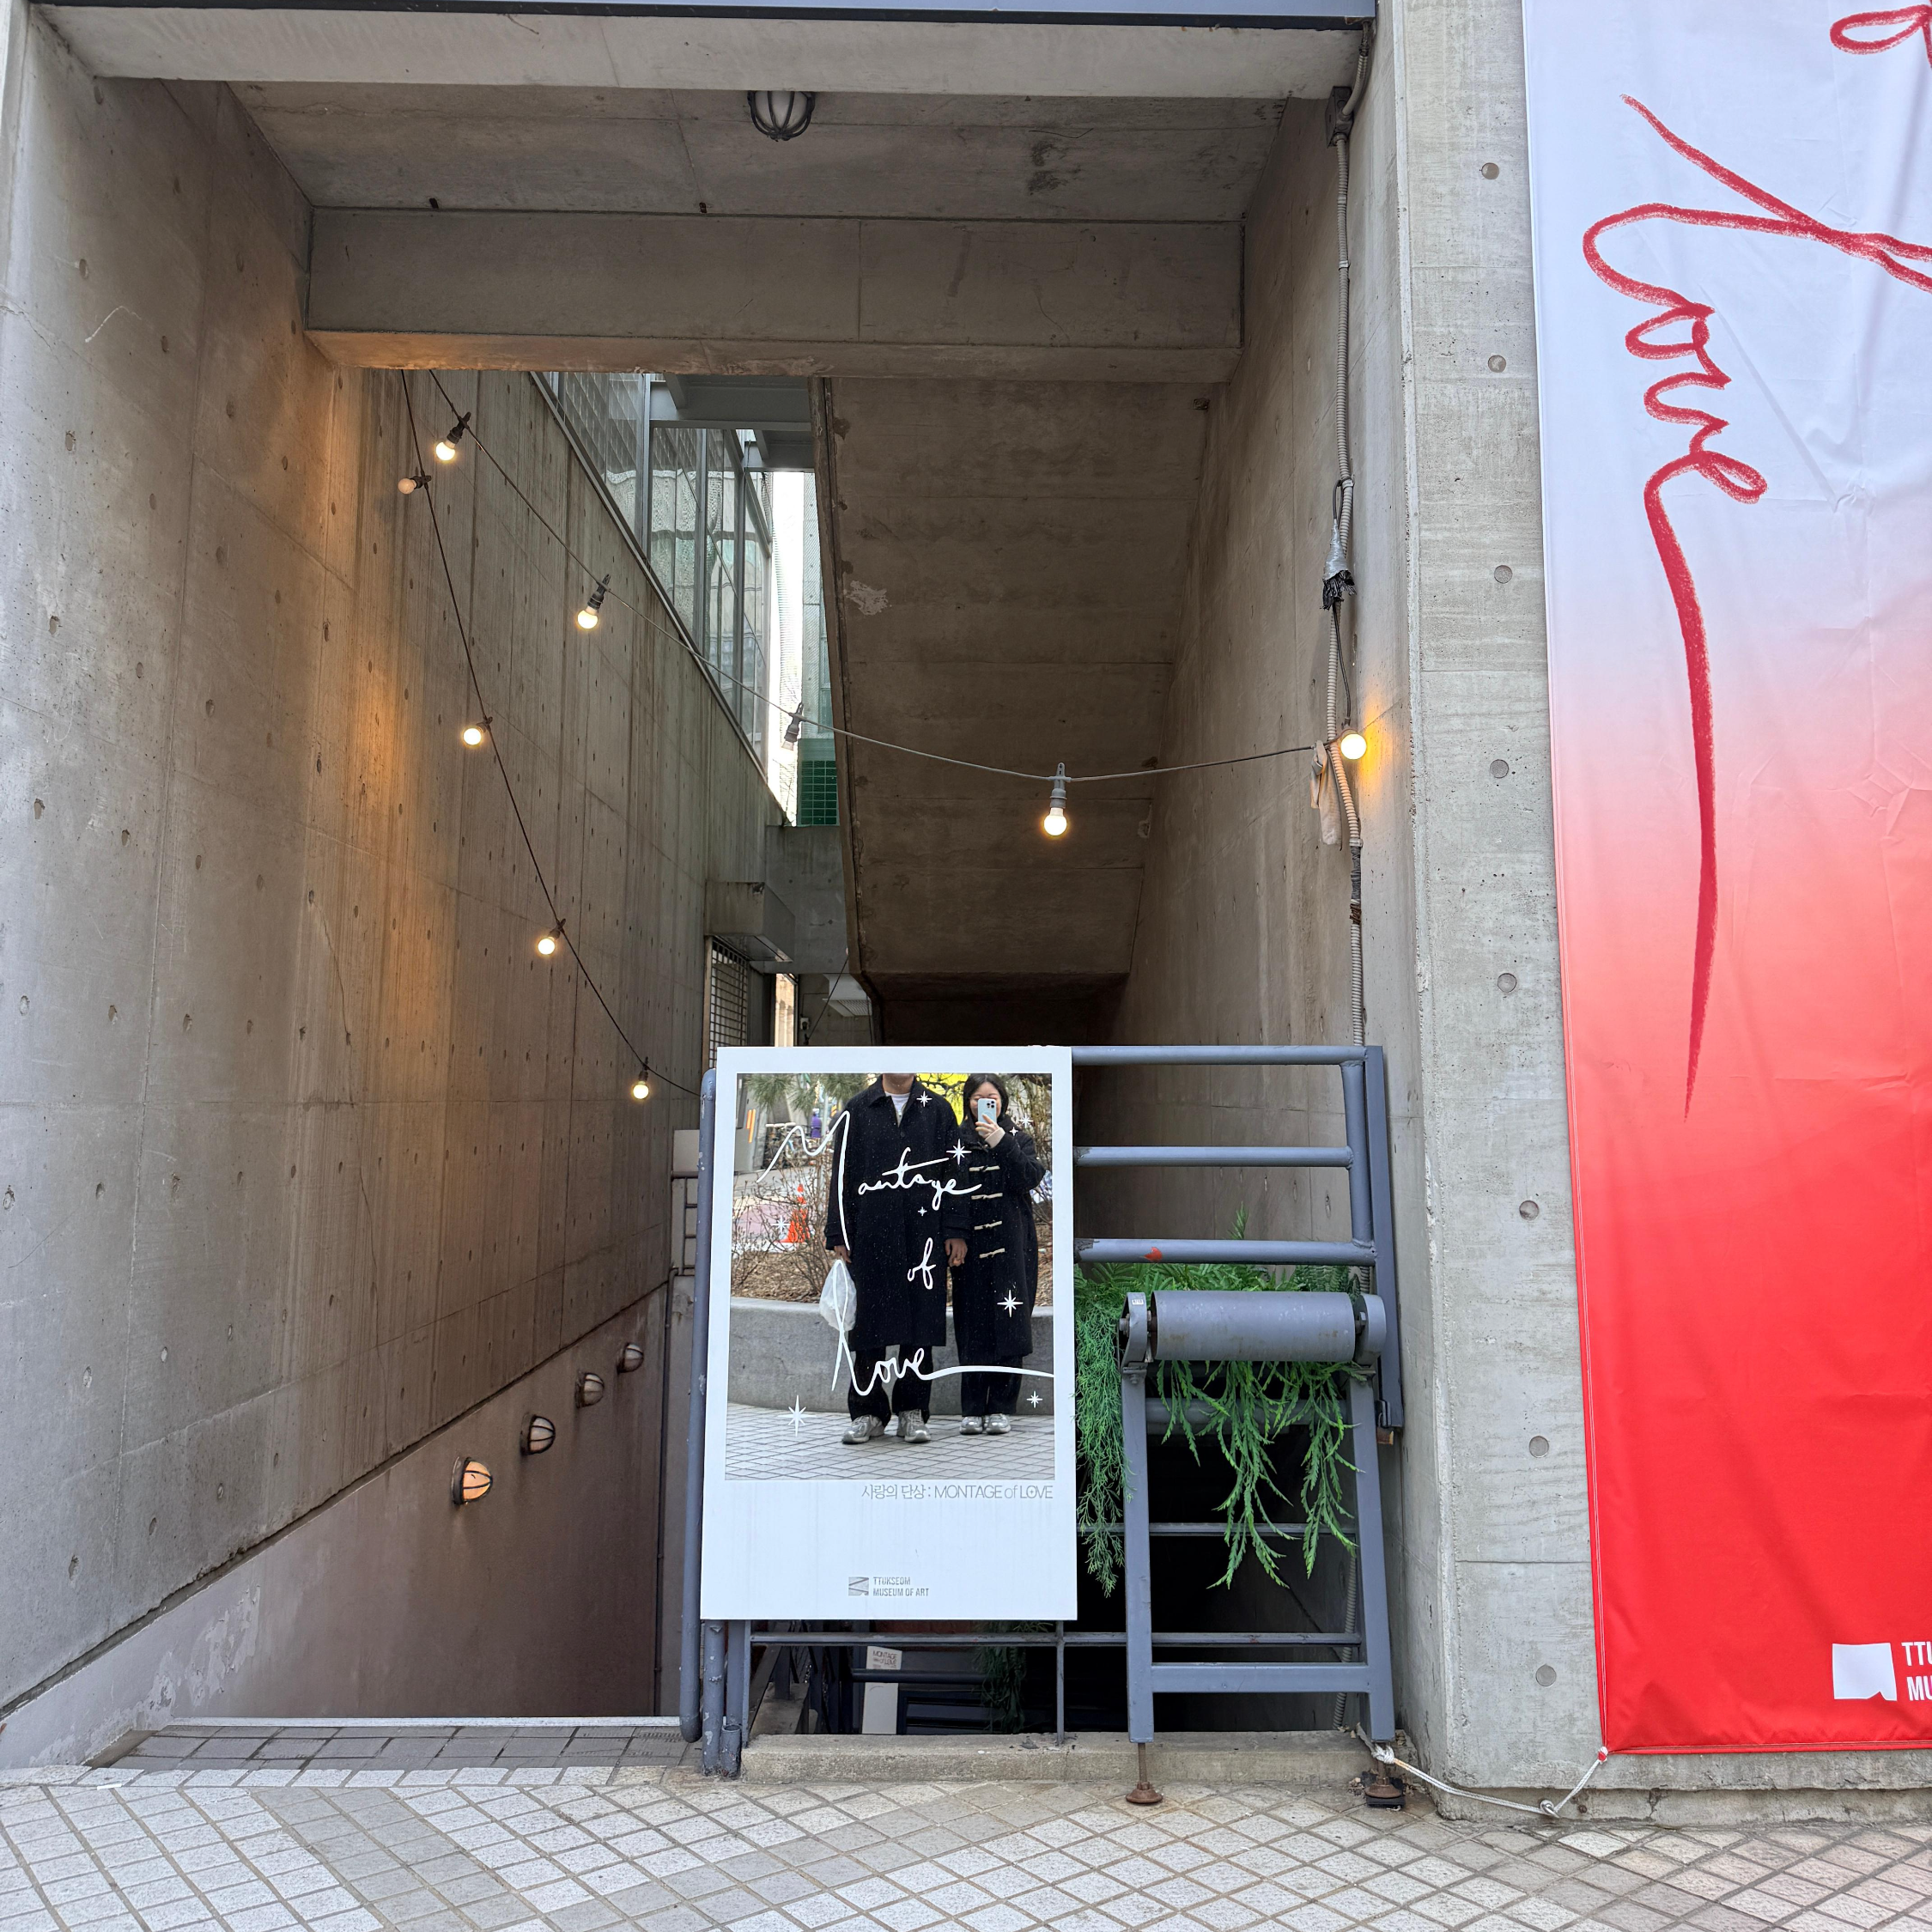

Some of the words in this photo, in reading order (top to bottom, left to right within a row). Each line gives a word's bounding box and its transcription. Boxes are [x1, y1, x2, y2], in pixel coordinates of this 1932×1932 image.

[907, 1236, 937, 1290] of
[830, 1259, 1054, 1396] Love
[861, 1484, 898, 1499] 사랑의
[934, 1485, 1003, 1499] MONTAGE
[1004, 1485, 1018, 1499] of
[1019, 1485, 1054, 1499] LOVE
[872, 1577, 911, 1585] TTUKSEOM
[872, 1588, 903, 1596] MUSEUM
[905, 1588, 914, 1596] OF
[915, 1588, 929, 1596] ART
